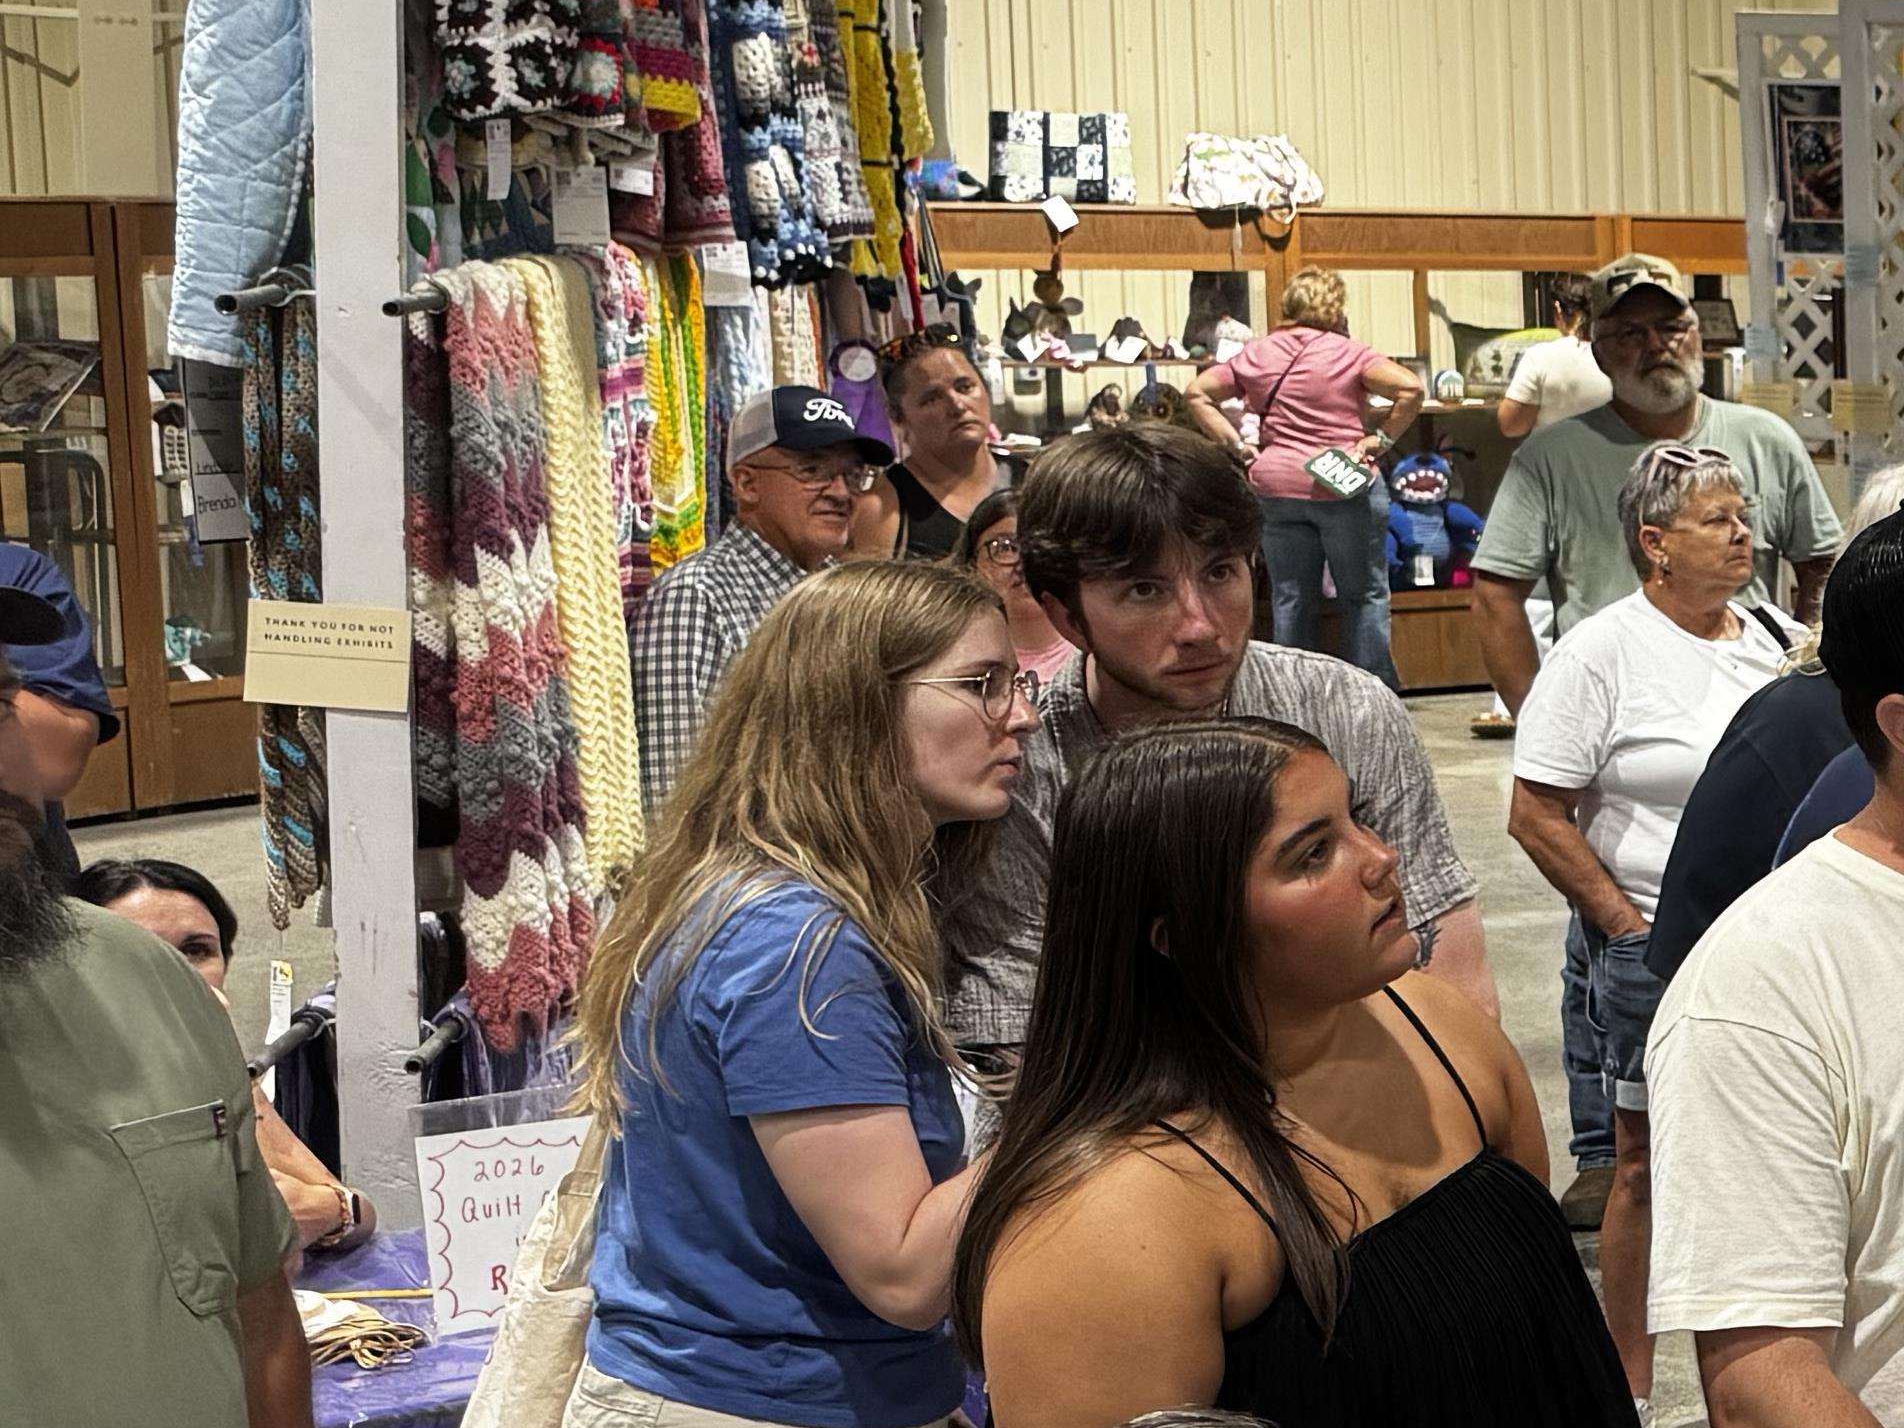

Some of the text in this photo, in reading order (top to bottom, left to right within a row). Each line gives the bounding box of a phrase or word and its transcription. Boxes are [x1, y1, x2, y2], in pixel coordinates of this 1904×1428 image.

[265, 617, 394, 634] THANK YOU FOR NOT
[265, 633, 331, 645] HANDLING
[474, 1156, 545, 1183] 2026
[461, 1194, 521, 1223] Quilt
